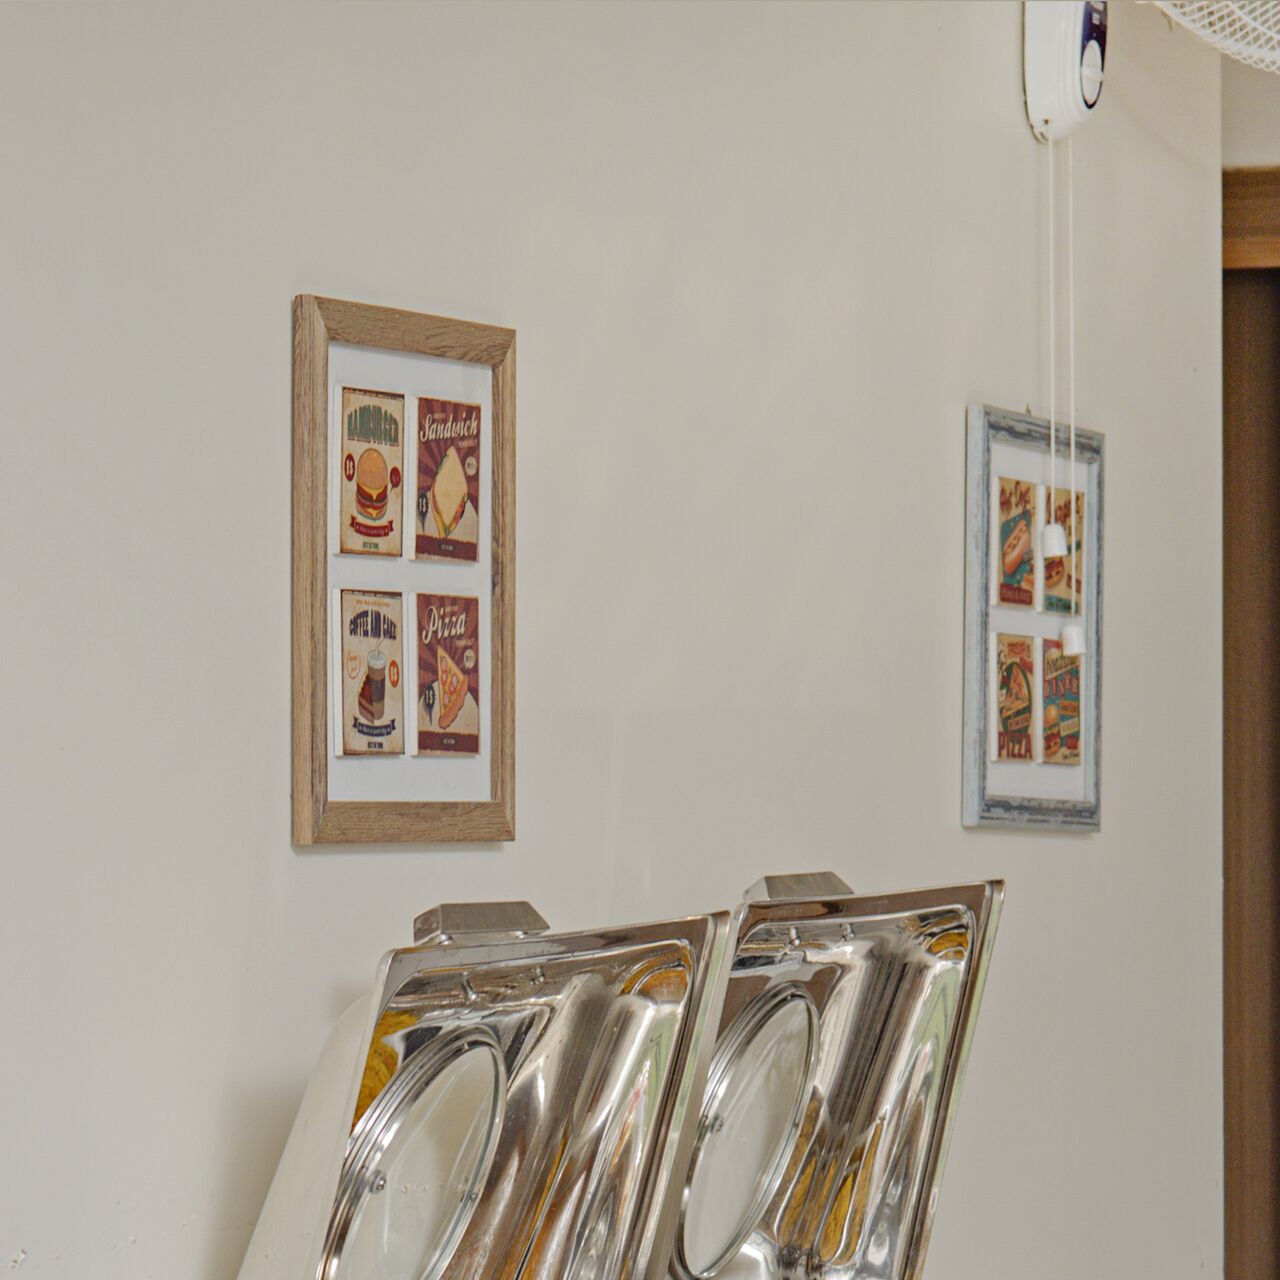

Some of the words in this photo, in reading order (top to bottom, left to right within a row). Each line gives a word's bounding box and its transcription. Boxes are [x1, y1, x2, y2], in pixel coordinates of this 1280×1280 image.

[420, 411, 478, 442] Sandwich
[422, 606, 466, 644] Pizza
[998, 731, 1032, 759] PIZZA
